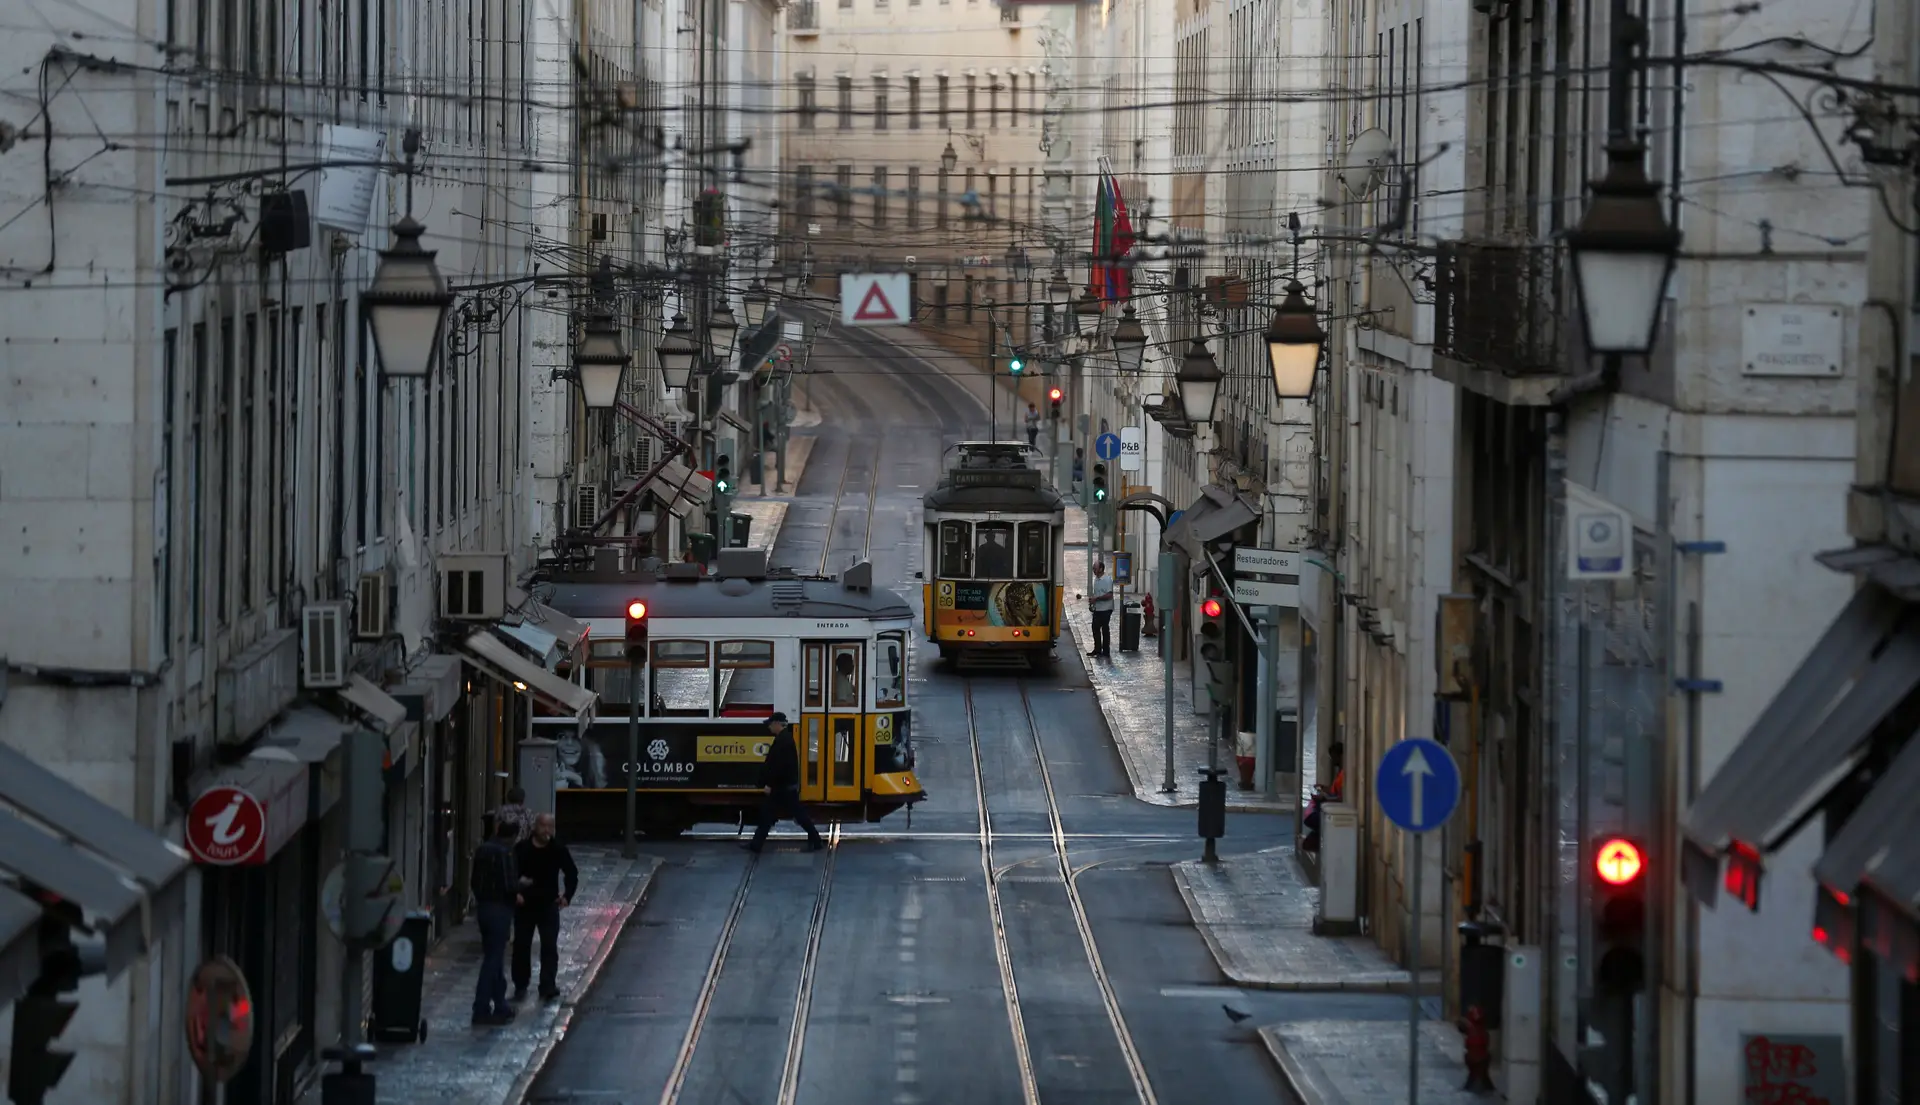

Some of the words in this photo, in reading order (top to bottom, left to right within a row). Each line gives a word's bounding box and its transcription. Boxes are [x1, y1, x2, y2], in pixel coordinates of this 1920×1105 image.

[1121, 442, 1140, 451] P&B
[1236, 554, 1289, 567] Restauradores
[1236, 586, 1260, 597] Rossio
[704, 741, 746, 755] carris
